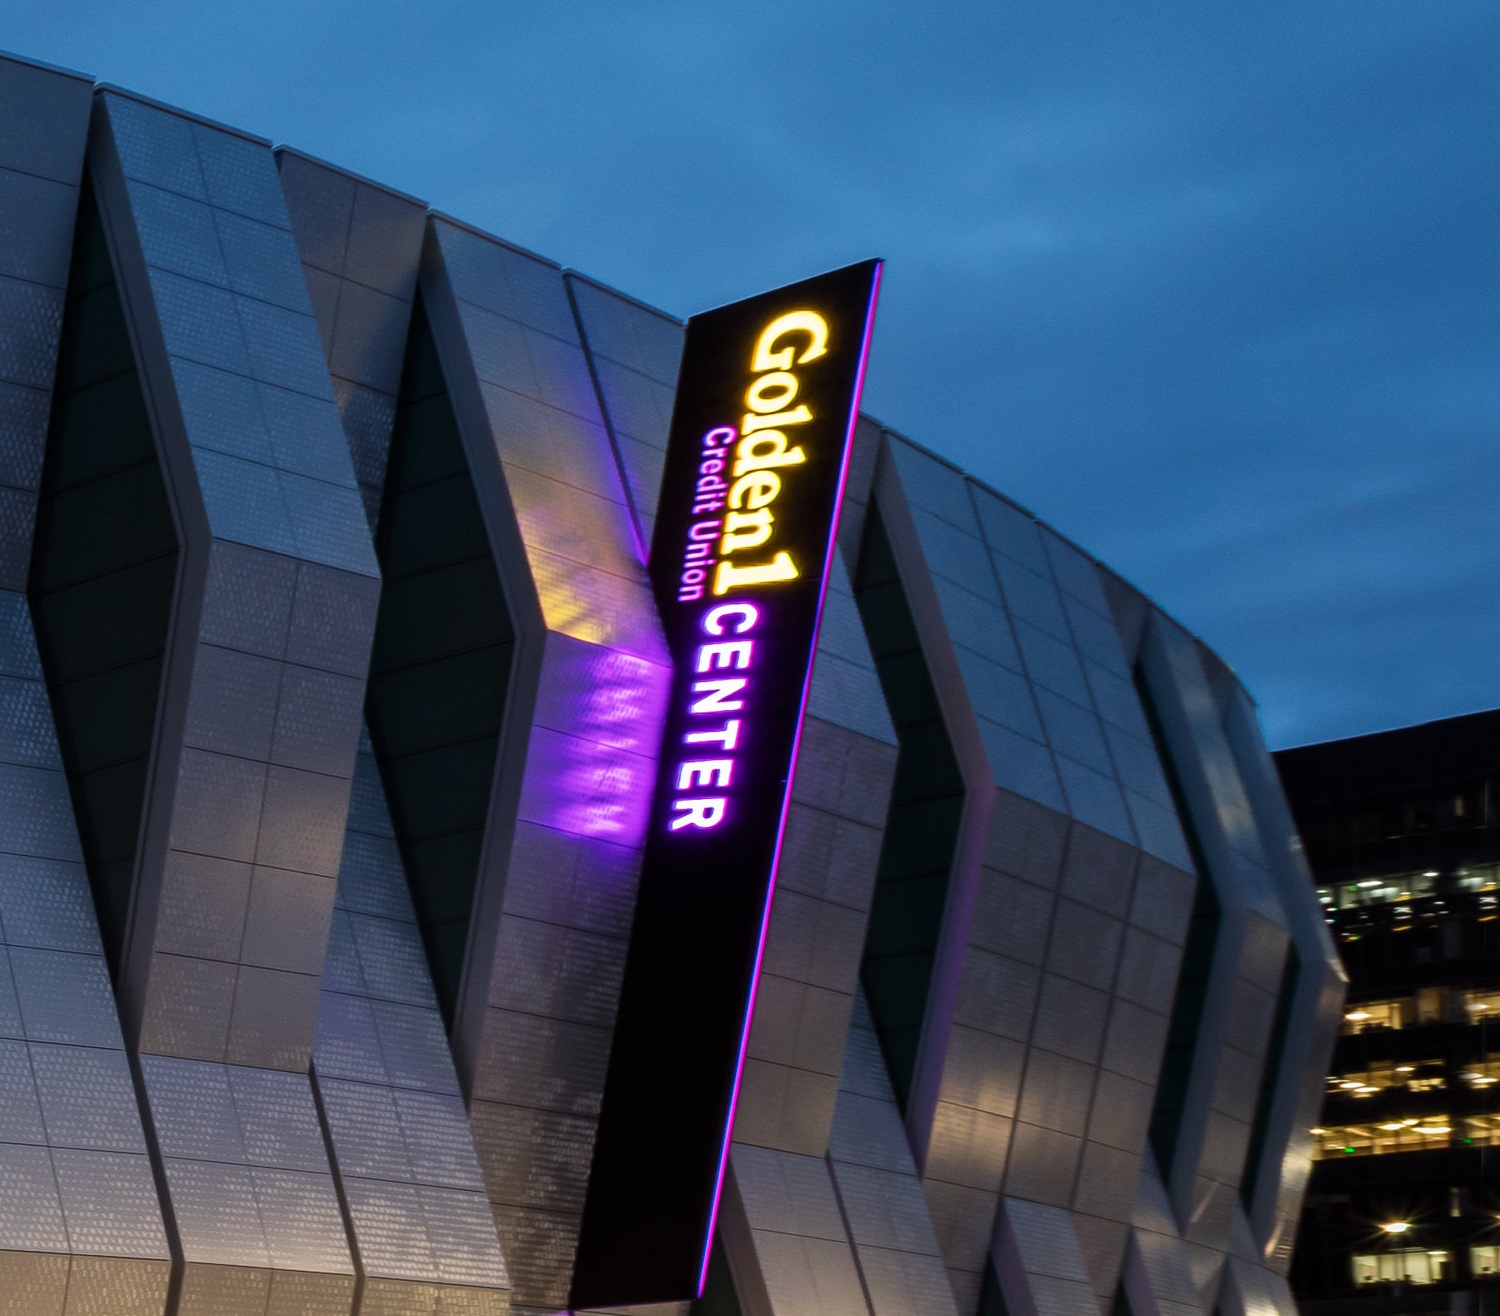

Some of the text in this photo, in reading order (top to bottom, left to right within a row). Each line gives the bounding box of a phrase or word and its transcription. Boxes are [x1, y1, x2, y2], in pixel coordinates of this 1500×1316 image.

[677, 425, 738, 603] Credit Union
[669, 601, 760, 831] CENTER
